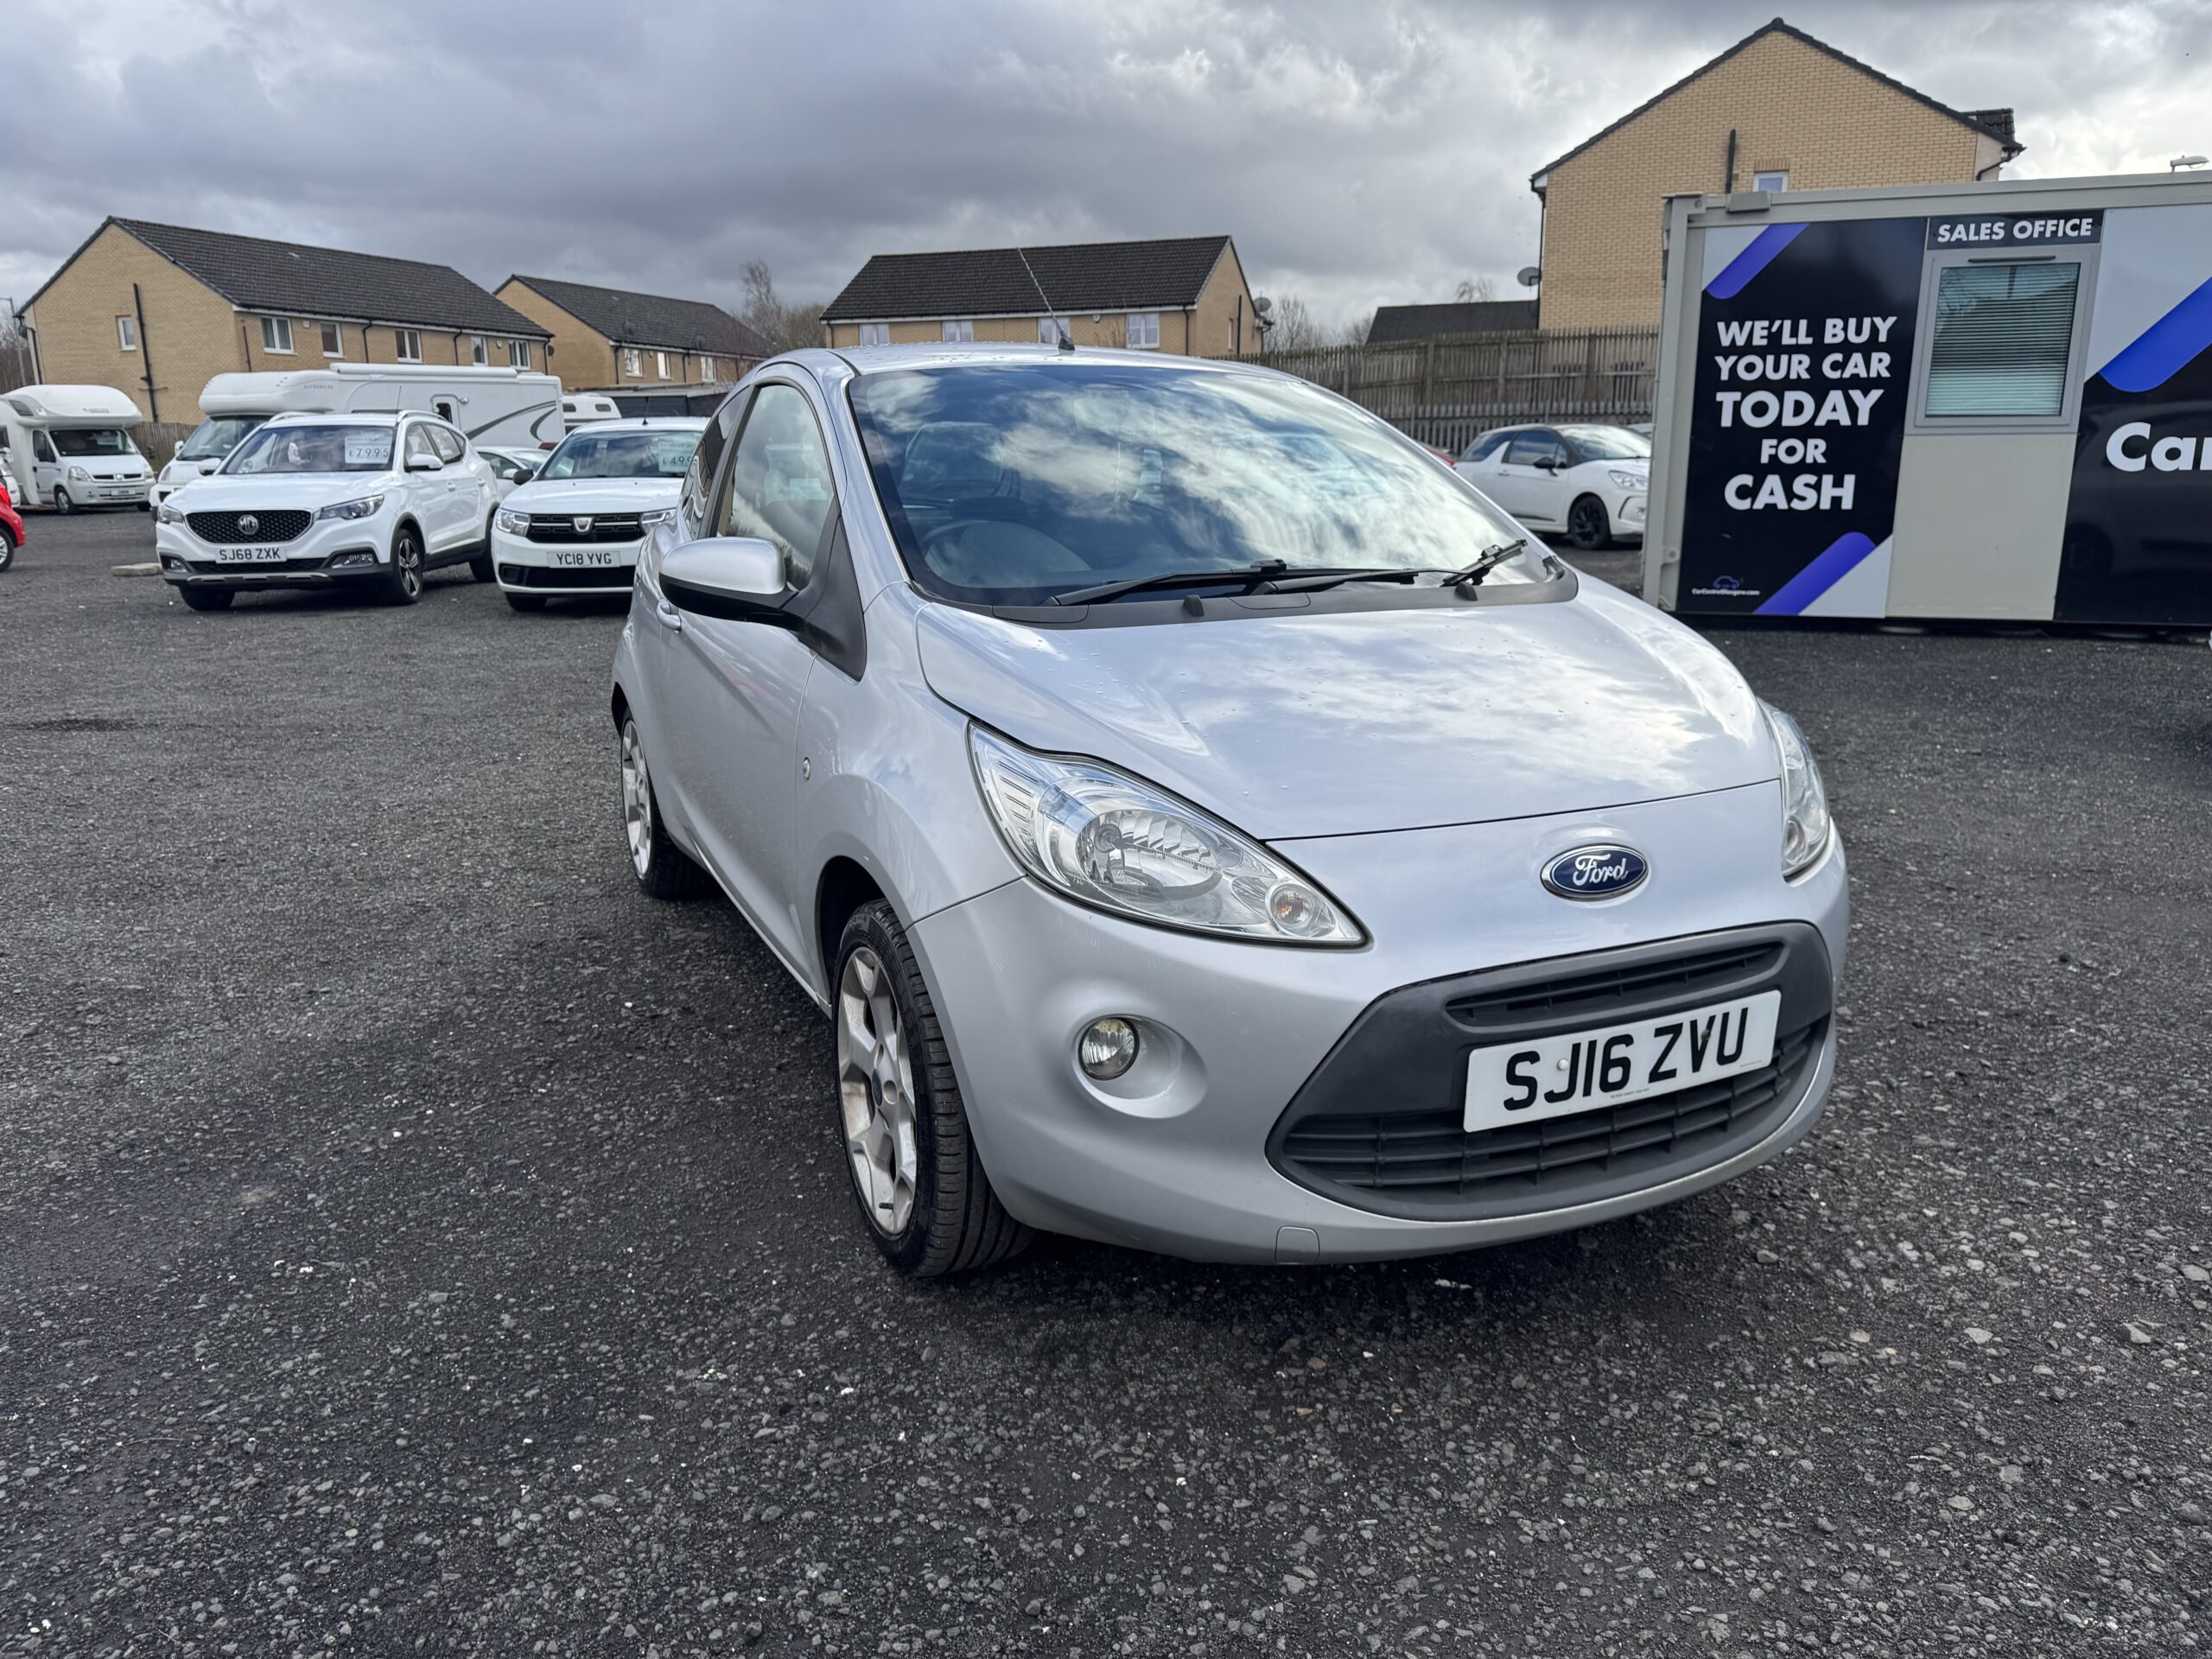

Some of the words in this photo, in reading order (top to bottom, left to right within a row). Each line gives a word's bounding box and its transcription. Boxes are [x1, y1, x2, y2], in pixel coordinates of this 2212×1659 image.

[1937, 221, 2005, 243] SALES
[2012, 218, 2093, 239] OFFICE
[1717, 319, 1813, 347] WE’LL
[1823, 315, 1897, 344] BUY
[1714, 353, 1811, 381] YOUR
[1821, 352, 1891, 378] CAR
[1715, 389, 1885, 428] TODAY
[1760, 438, 1827, 464] FOR
[1724, 474, 1856, 511] CASH
[219, 549, 252, 561] SJ68
[256, 547, 281, 560] ZXK
[556, 553, 584, 566] YC18
[587, 553, 612, 565] YVG
[1573, 853, 1629, 886] Ford
[1503, 1033, 1634, 1111] SJ16
[1648, 1006, 1749, 1084] ZVU
